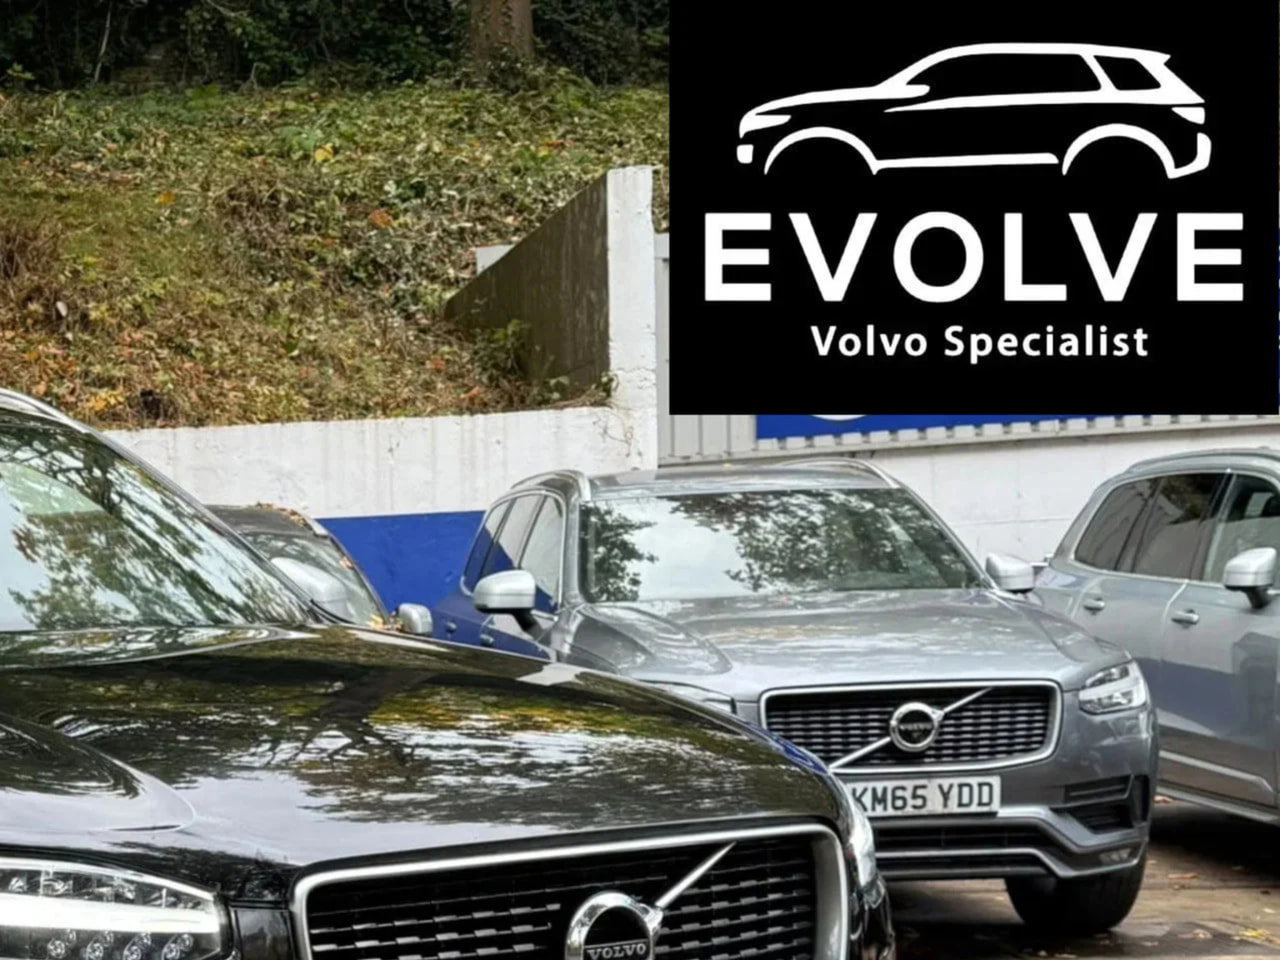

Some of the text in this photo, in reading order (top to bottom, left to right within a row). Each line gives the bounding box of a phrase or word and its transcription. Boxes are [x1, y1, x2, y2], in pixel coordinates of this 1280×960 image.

[852, 781, 994, 812] KM65 YDD
[586, 943, 647, 960] VOLVO
